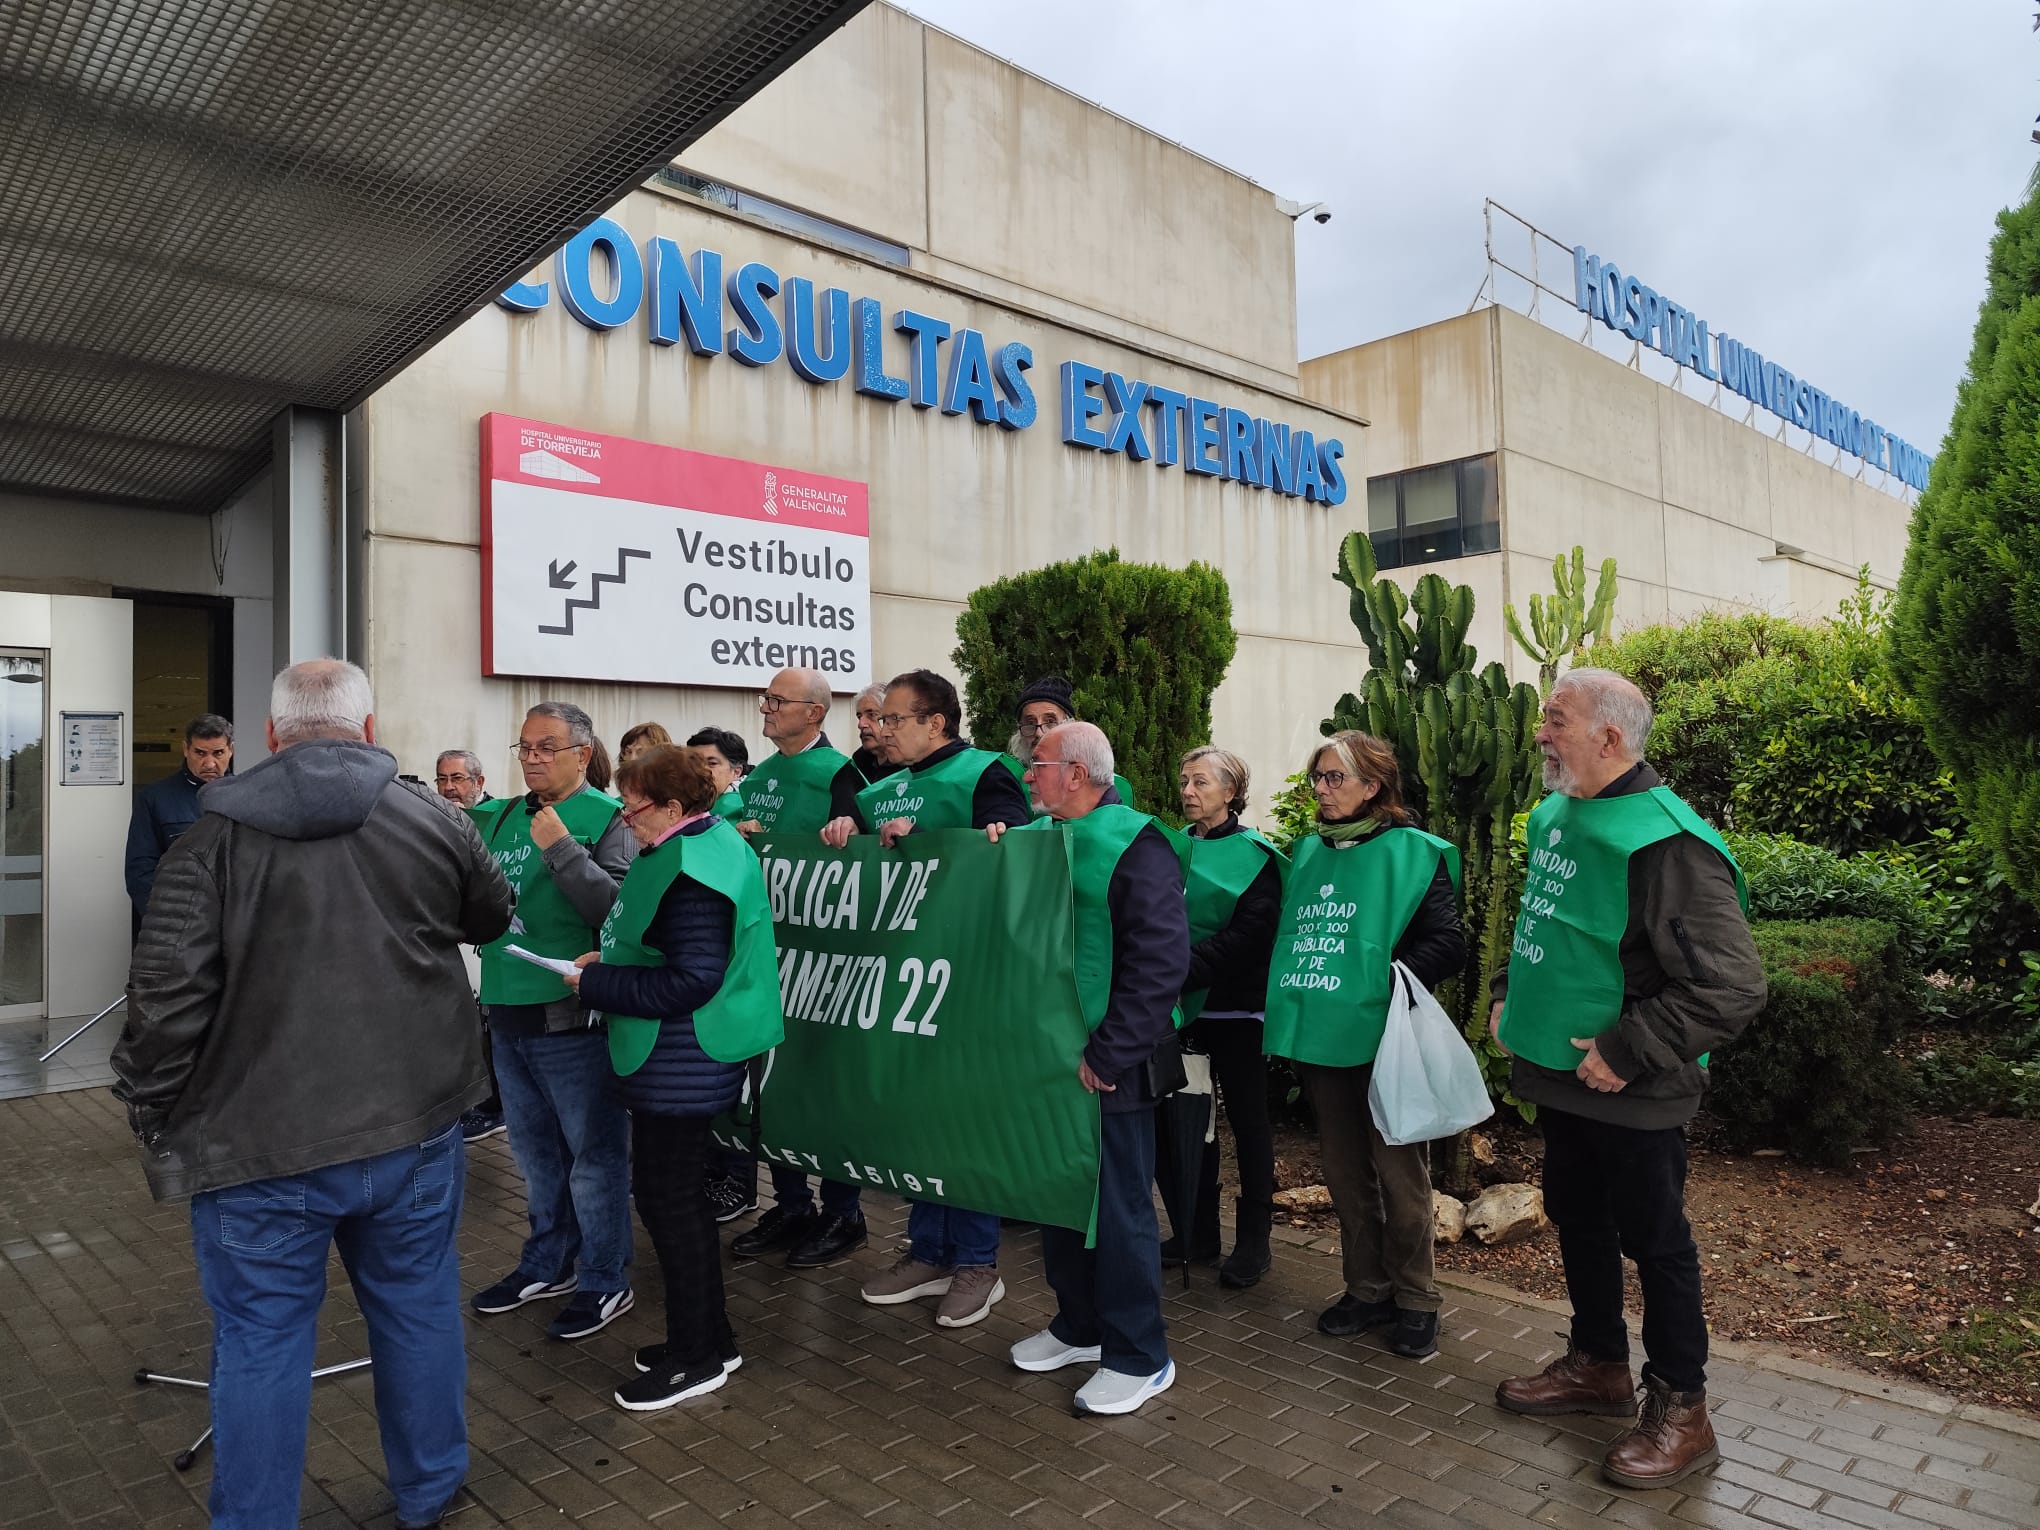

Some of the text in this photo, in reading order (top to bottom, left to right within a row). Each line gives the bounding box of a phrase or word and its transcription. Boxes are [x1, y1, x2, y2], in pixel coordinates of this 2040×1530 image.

[1573, 245, 1717, 381] HOSPITAL
[1718, 332, 1864, 457] UNIVERSITARIO
[1863, 418, 1888, 472] DE
[521, 428, 602, 449] HOSPITAL UNIVERSITARIO
[1060, 360, 1347, 506] EXTERNAS
[521, 436, 602, 459] DE TORREVIEJA
[781, 484, 848, 505] GENERALITAT
[782, 497, 847, 517] VALENCIANA
[676, 527, 854, 582] Vestíbulo
[684, 582, 855, 631] Consultas
[711, 636, 856, 673] externas
[748, 792, 784, 810] SANIDAD
[873, 797, 924, 816] SANIDAD
[871, 861, 902, 932] Y
[888, 858, 940, 931] DE
[1542, 879, 1564, 896] 100
[1296, 902, 1357, 921] SANIDAD
[1297, 923, 1314, 935] 100
[1326, 923, 1349, 933] 100
[1292, 936, 1345, 954] PÚBLICA
[1309, 956, 1327, 970] DE
[1280, 973, 1341, 991] CALIDAD
[892, 957, 951, 1037] 22
[761, 1143, 822, 1171] LEY
[843, 1160, 945, 1197] 15/97
